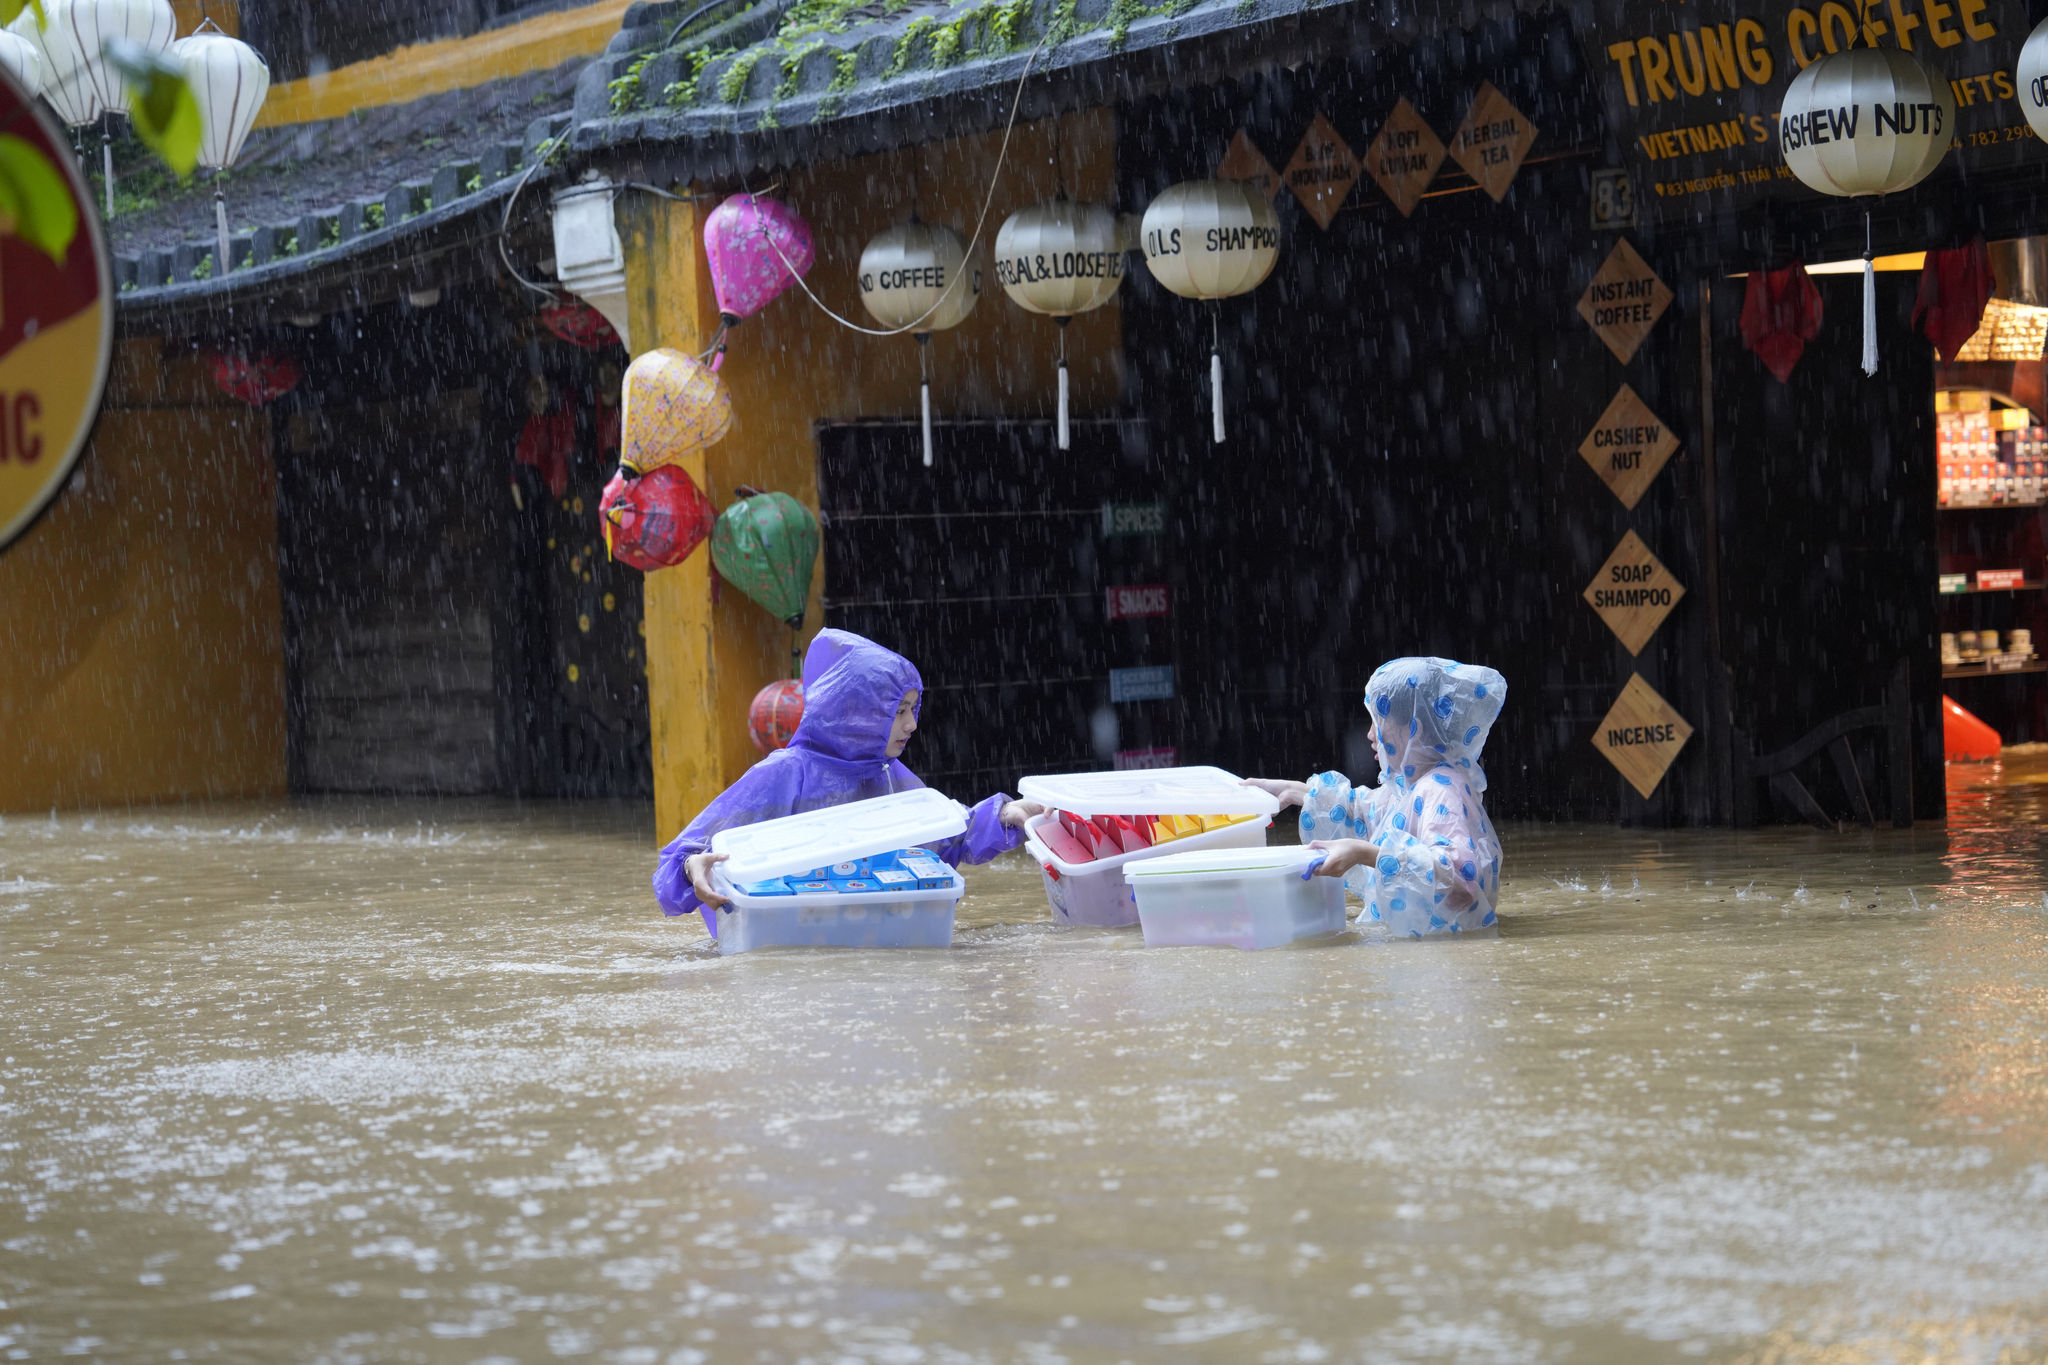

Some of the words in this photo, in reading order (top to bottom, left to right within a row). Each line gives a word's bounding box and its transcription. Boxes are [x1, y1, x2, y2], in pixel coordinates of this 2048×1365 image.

[1608, 18, 1774, 107] TRUNG
[1951, 70, 2014, 107] IFTS
[1463, 118, 1520, 147] HERBAL
[1639, 113, 1769, 160] VIETNAM'S
[1782, 104, 1859, 153] ASHEW
[1874, 102, 1943, 136] NUTS
[1481, 144, 1509, 165] TEA
[1596, 177, 1632, 219] 83
[1666, 182, 1684, 197] 83
[1206, 226, 1277, 252] SHAMPOO
[880, 266, 945, 289] COFFEE
[1591, 278, 1655, 303] INSTANT
[1594, 303, 1653, 326] COFFEE
[1594, 425, 1660, 448] CASHEW
[1612, 451, 1642, 471] NUT
[1611, 564, 1652, 583] SOAP
[1594, 588, 1671, 608] SHAMPOO
[1608, 723, 1676, 747] INCENSE
